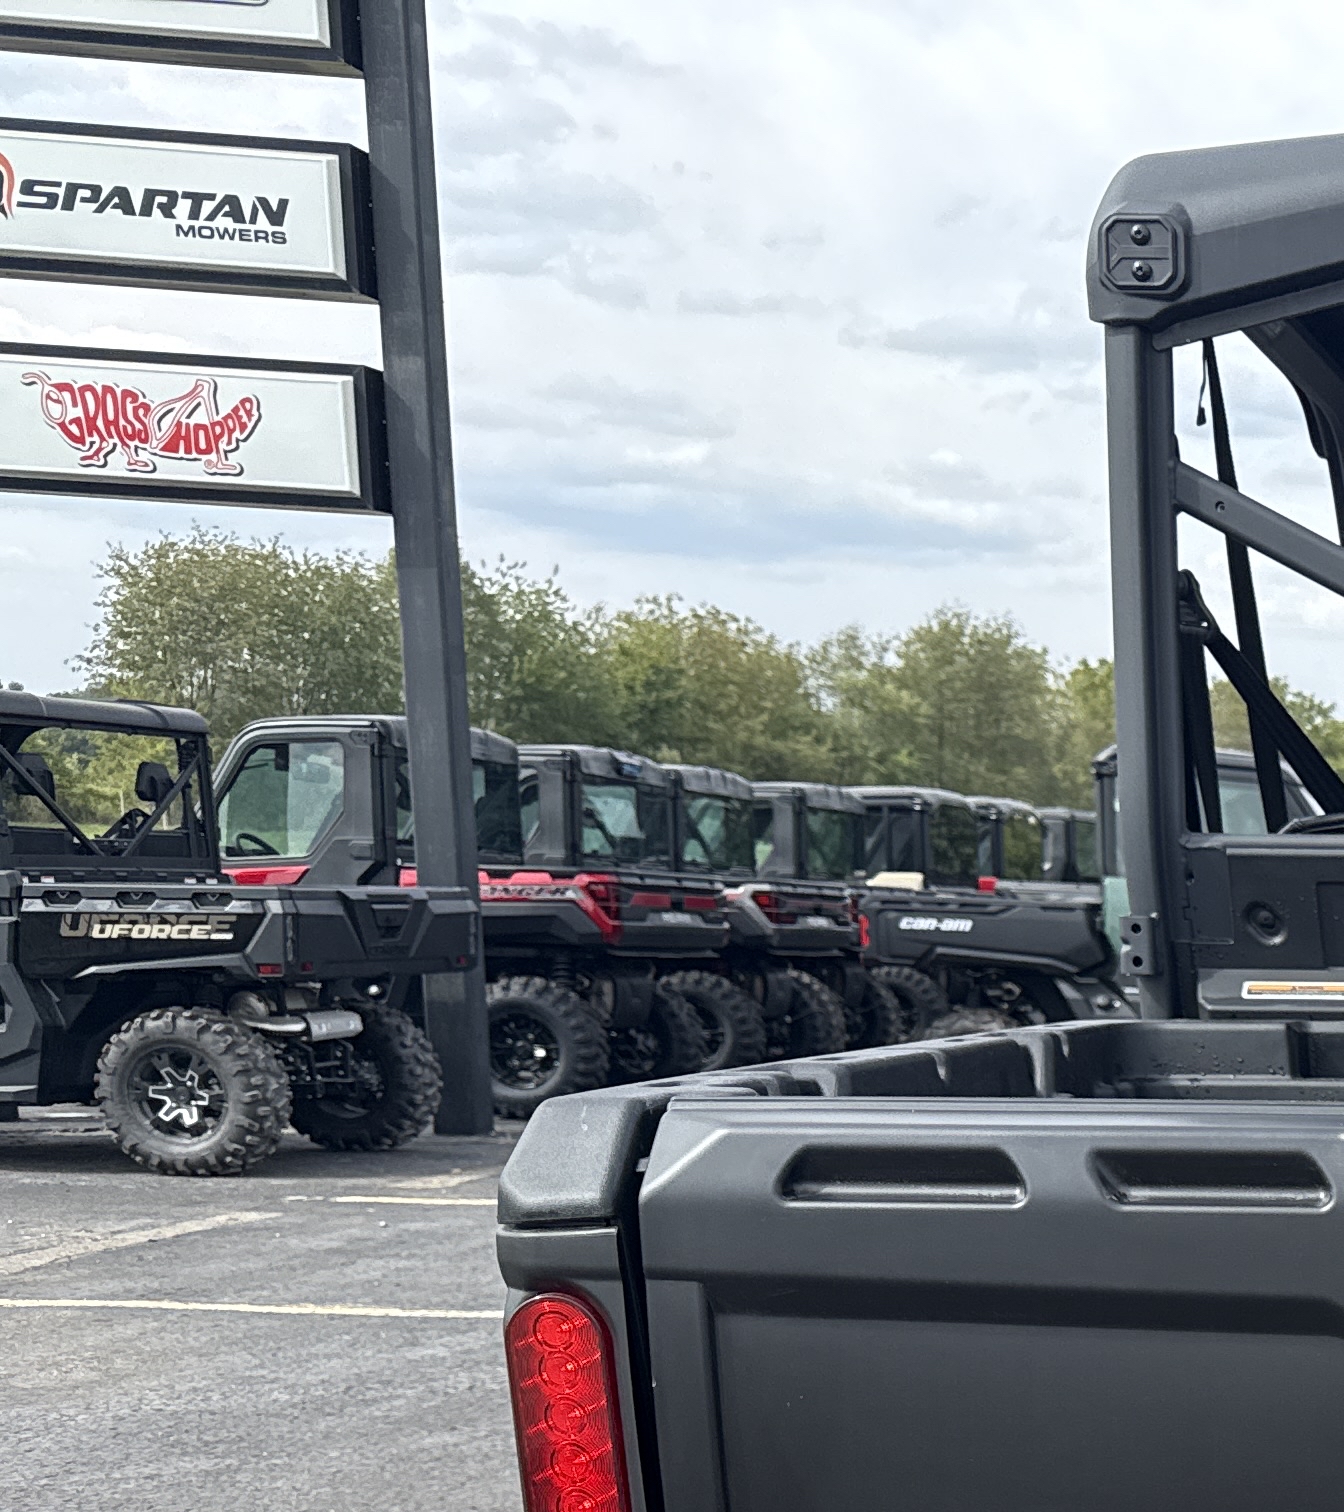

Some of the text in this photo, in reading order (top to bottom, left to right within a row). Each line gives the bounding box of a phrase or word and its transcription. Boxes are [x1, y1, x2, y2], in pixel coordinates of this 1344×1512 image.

[15, 178, 290, 228] SPARTAN
[174, 223, 288, 245] MOWERS
[91, 923, 212, 940] UFORCE
[898, 916, 974, 933] can-am
